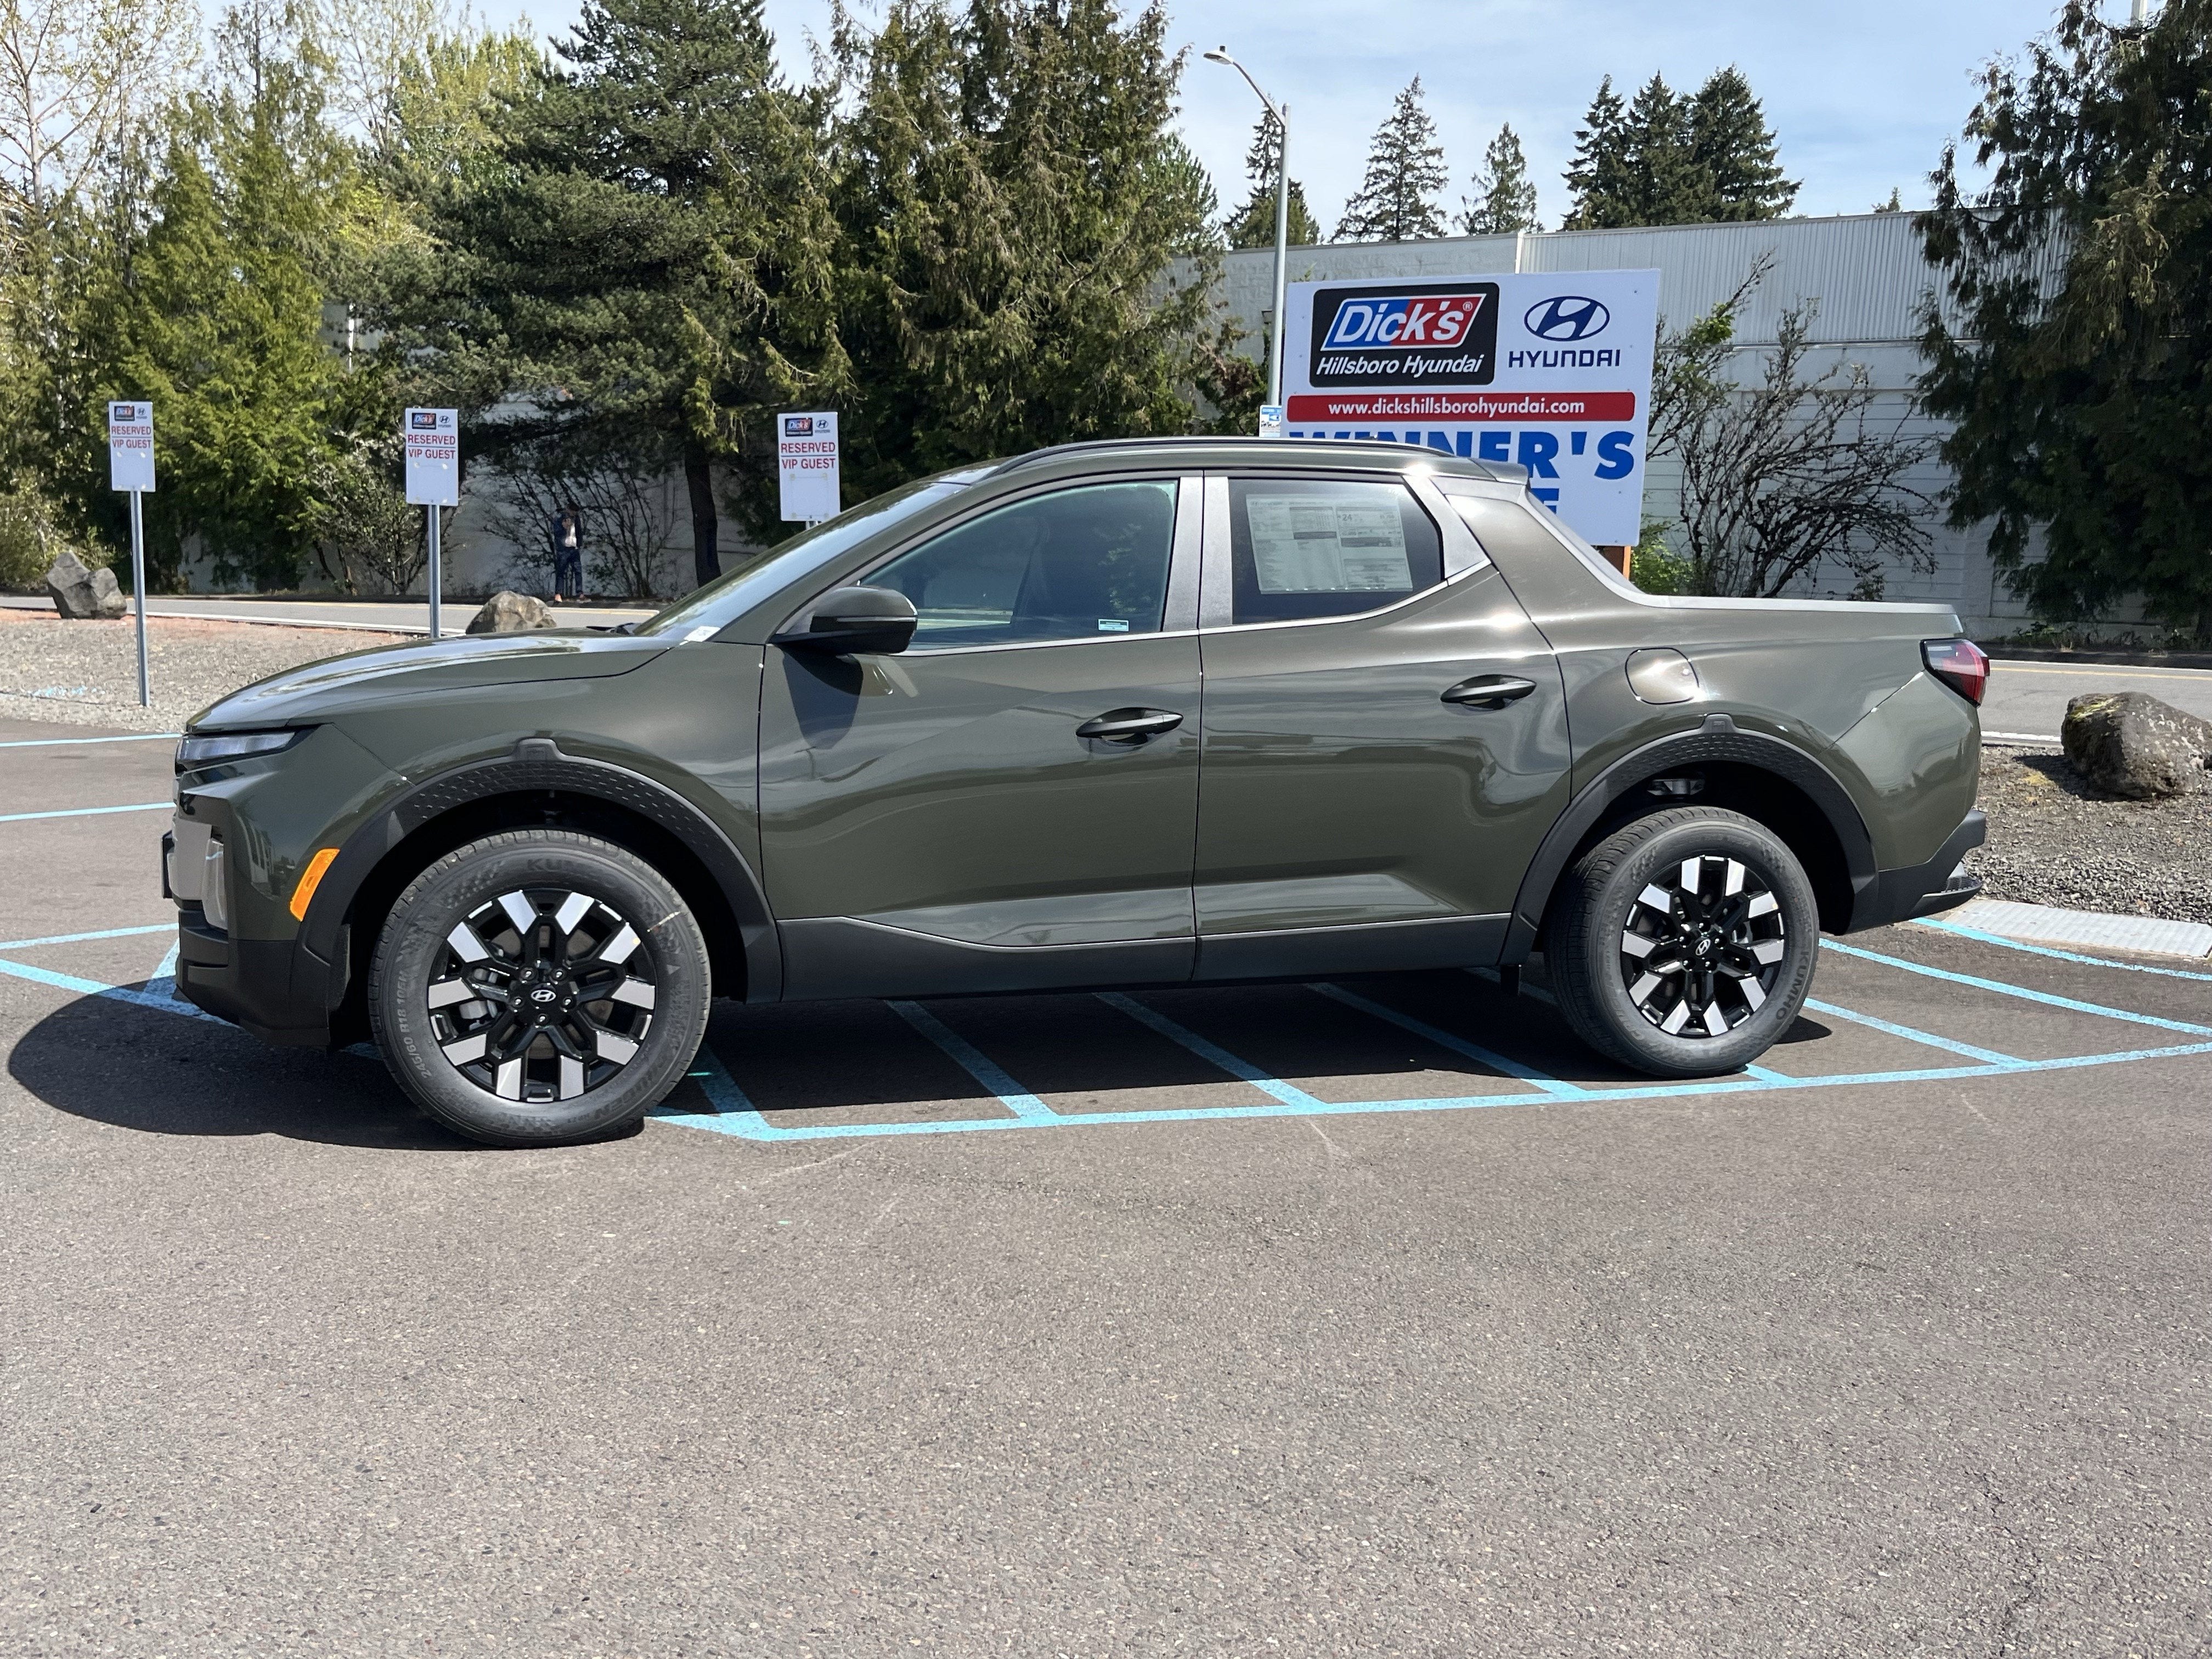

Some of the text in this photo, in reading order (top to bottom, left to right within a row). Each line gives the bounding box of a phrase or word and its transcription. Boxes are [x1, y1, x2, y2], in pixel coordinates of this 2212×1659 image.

[1333, 301, 1464, 343] Dick's
[1316, 354, 1485, 379] Hillsboro Hyundai
[1508, 349, 1621, 368] HYUNDAI
[1328, 397, 1585, 418] www.dickshillsborohyundai.com
[111, 426, 151, 435] RESERVED
[408, 434, 456, 445] RESERVED
[112, 439, 151, 449] VIP GUEST
[408, 448, 456, 459] VIP GUEST
[781, 442, 836, 454] RESERVED
[781, 458, 836, 469] VIP GUEST
[1289, 430, 1636, 480] ER'S
[1776, 951, 1809, 1020] KUMHO
[397, 1008, 410, 1032] R18
